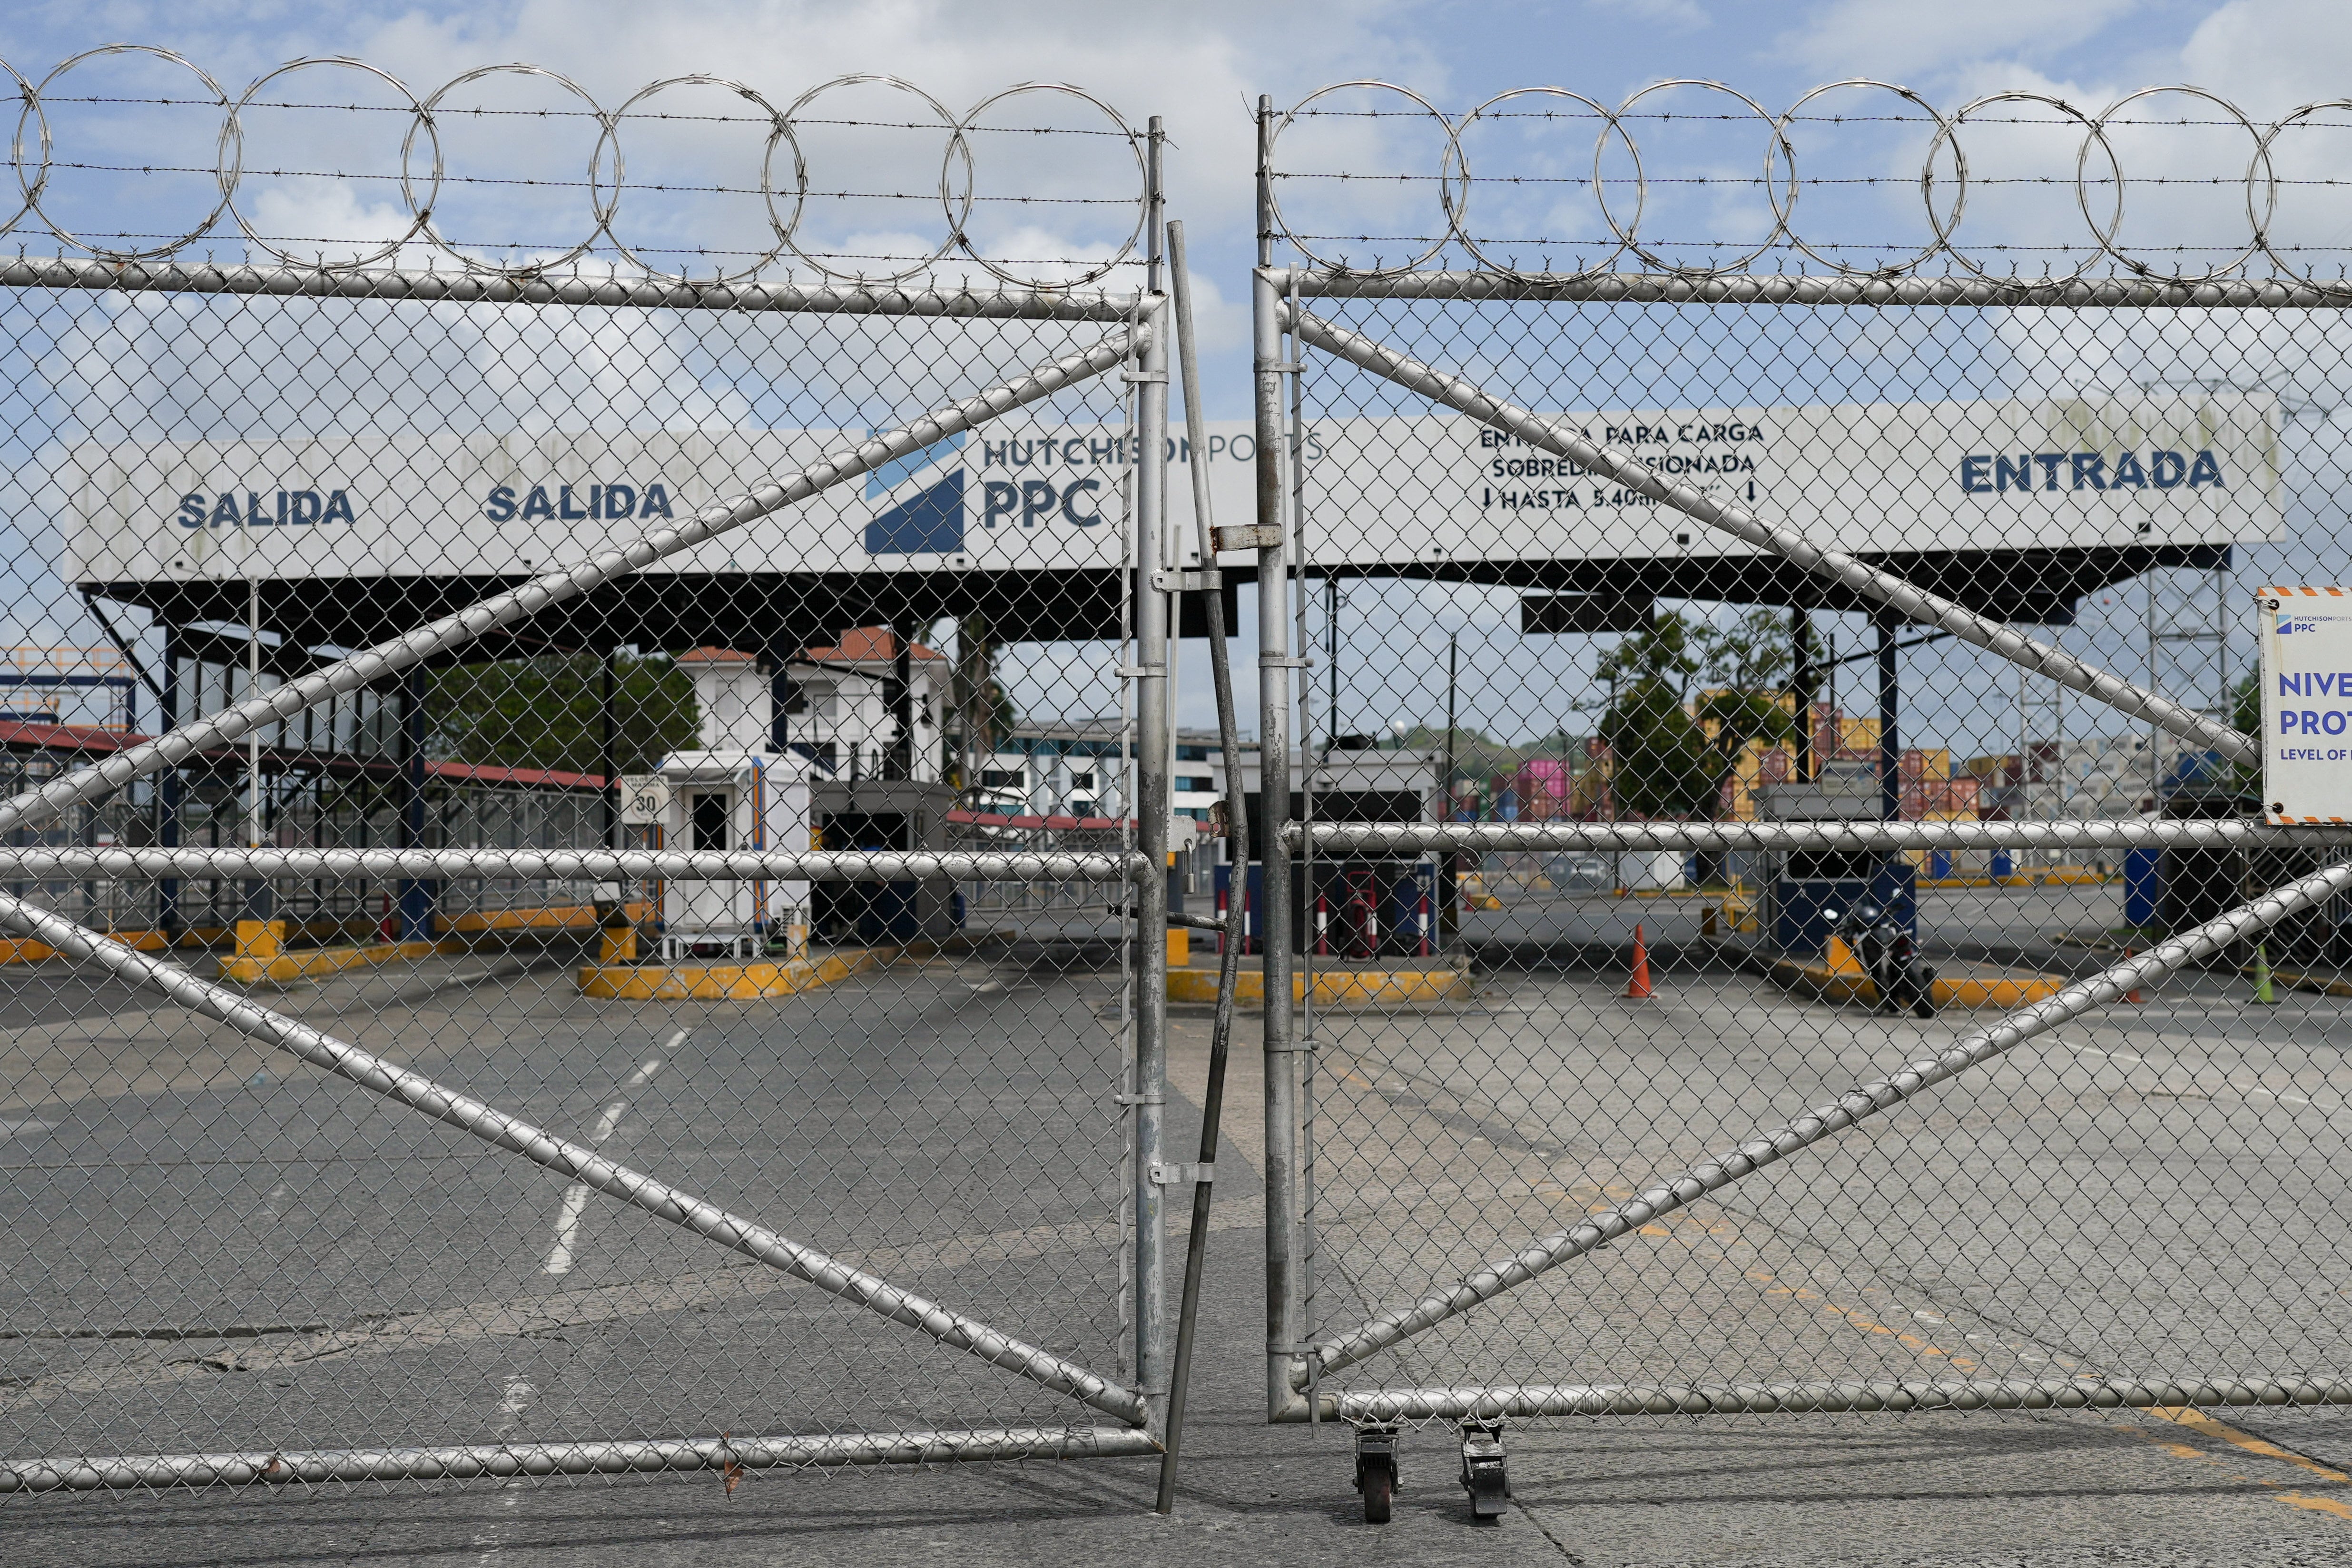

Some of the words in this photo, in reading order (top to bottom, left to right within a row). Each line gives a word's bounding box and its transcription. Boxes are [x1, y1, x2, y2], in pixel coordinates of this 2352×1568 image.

[1606, 426, 1669, 444] PARA
[1678, 423, 1764, 443] CARGA
[1960, 450, 2226, 493] ENTRADA
[177, 489, 355, 529] SALIDA
[486, 483, 674, 522] SALIDA
[984, 479, 1102, 528] PPC
[1501, 490, 1581, 509] HASTA
[2294, 623, 2315, 632] PPC
[2280, 672, 2352, 697] NIVE
[2281, 749, 2323, 760] LEVEL
[2327, 749, 2346, 760] OF
[636, 796, 655, 811] 30
